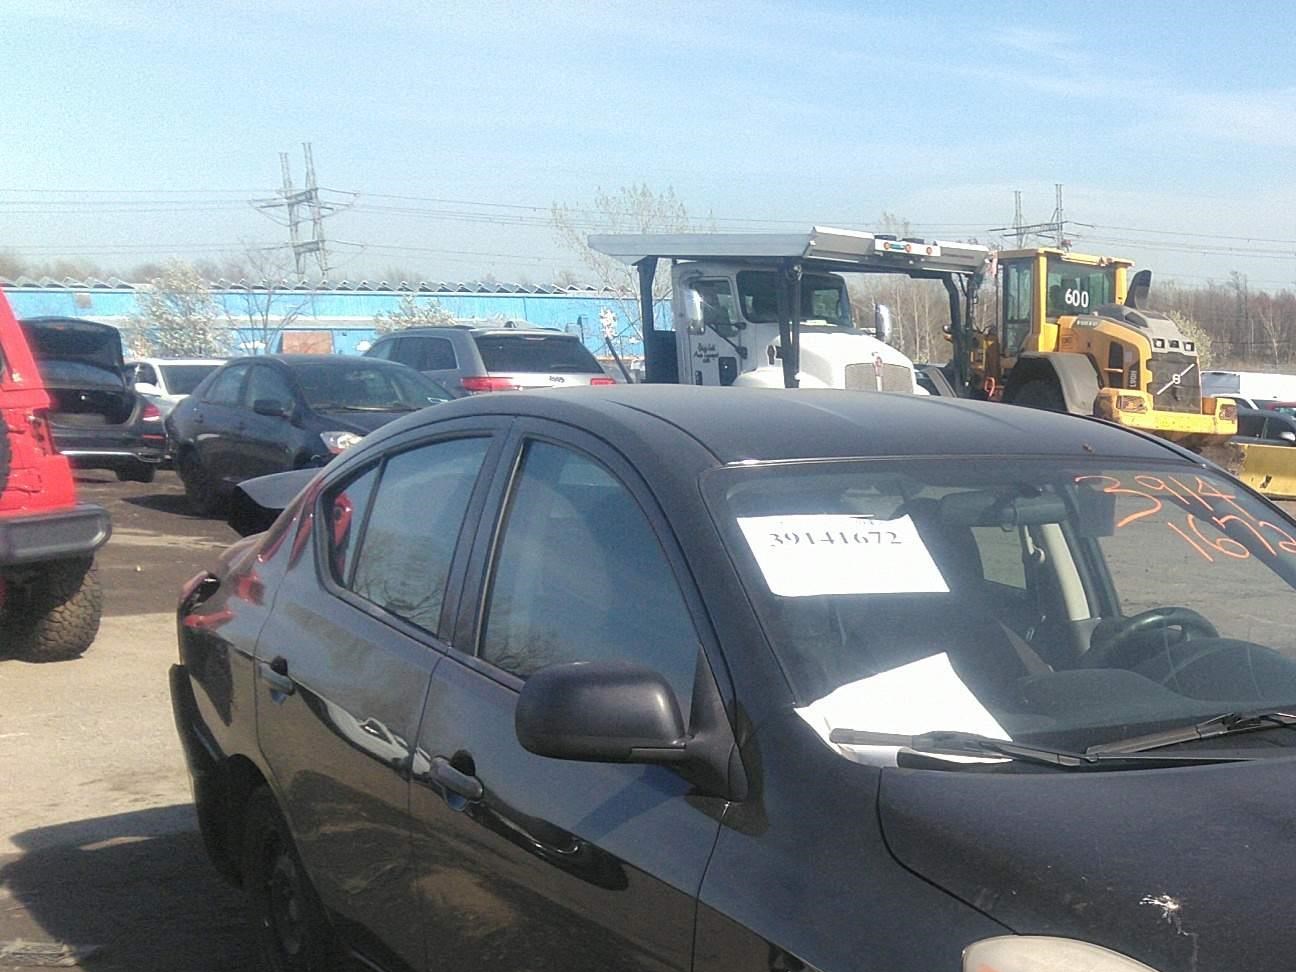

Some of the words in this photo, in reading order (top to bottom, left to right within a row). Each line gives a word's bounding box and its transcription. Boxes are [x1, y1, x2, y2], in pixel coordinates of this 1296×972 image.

[1065, 288, 1089, 308] 600
[1075, 475, 1259, 528] 3914
[768, 531, 903, 547] 39141672
